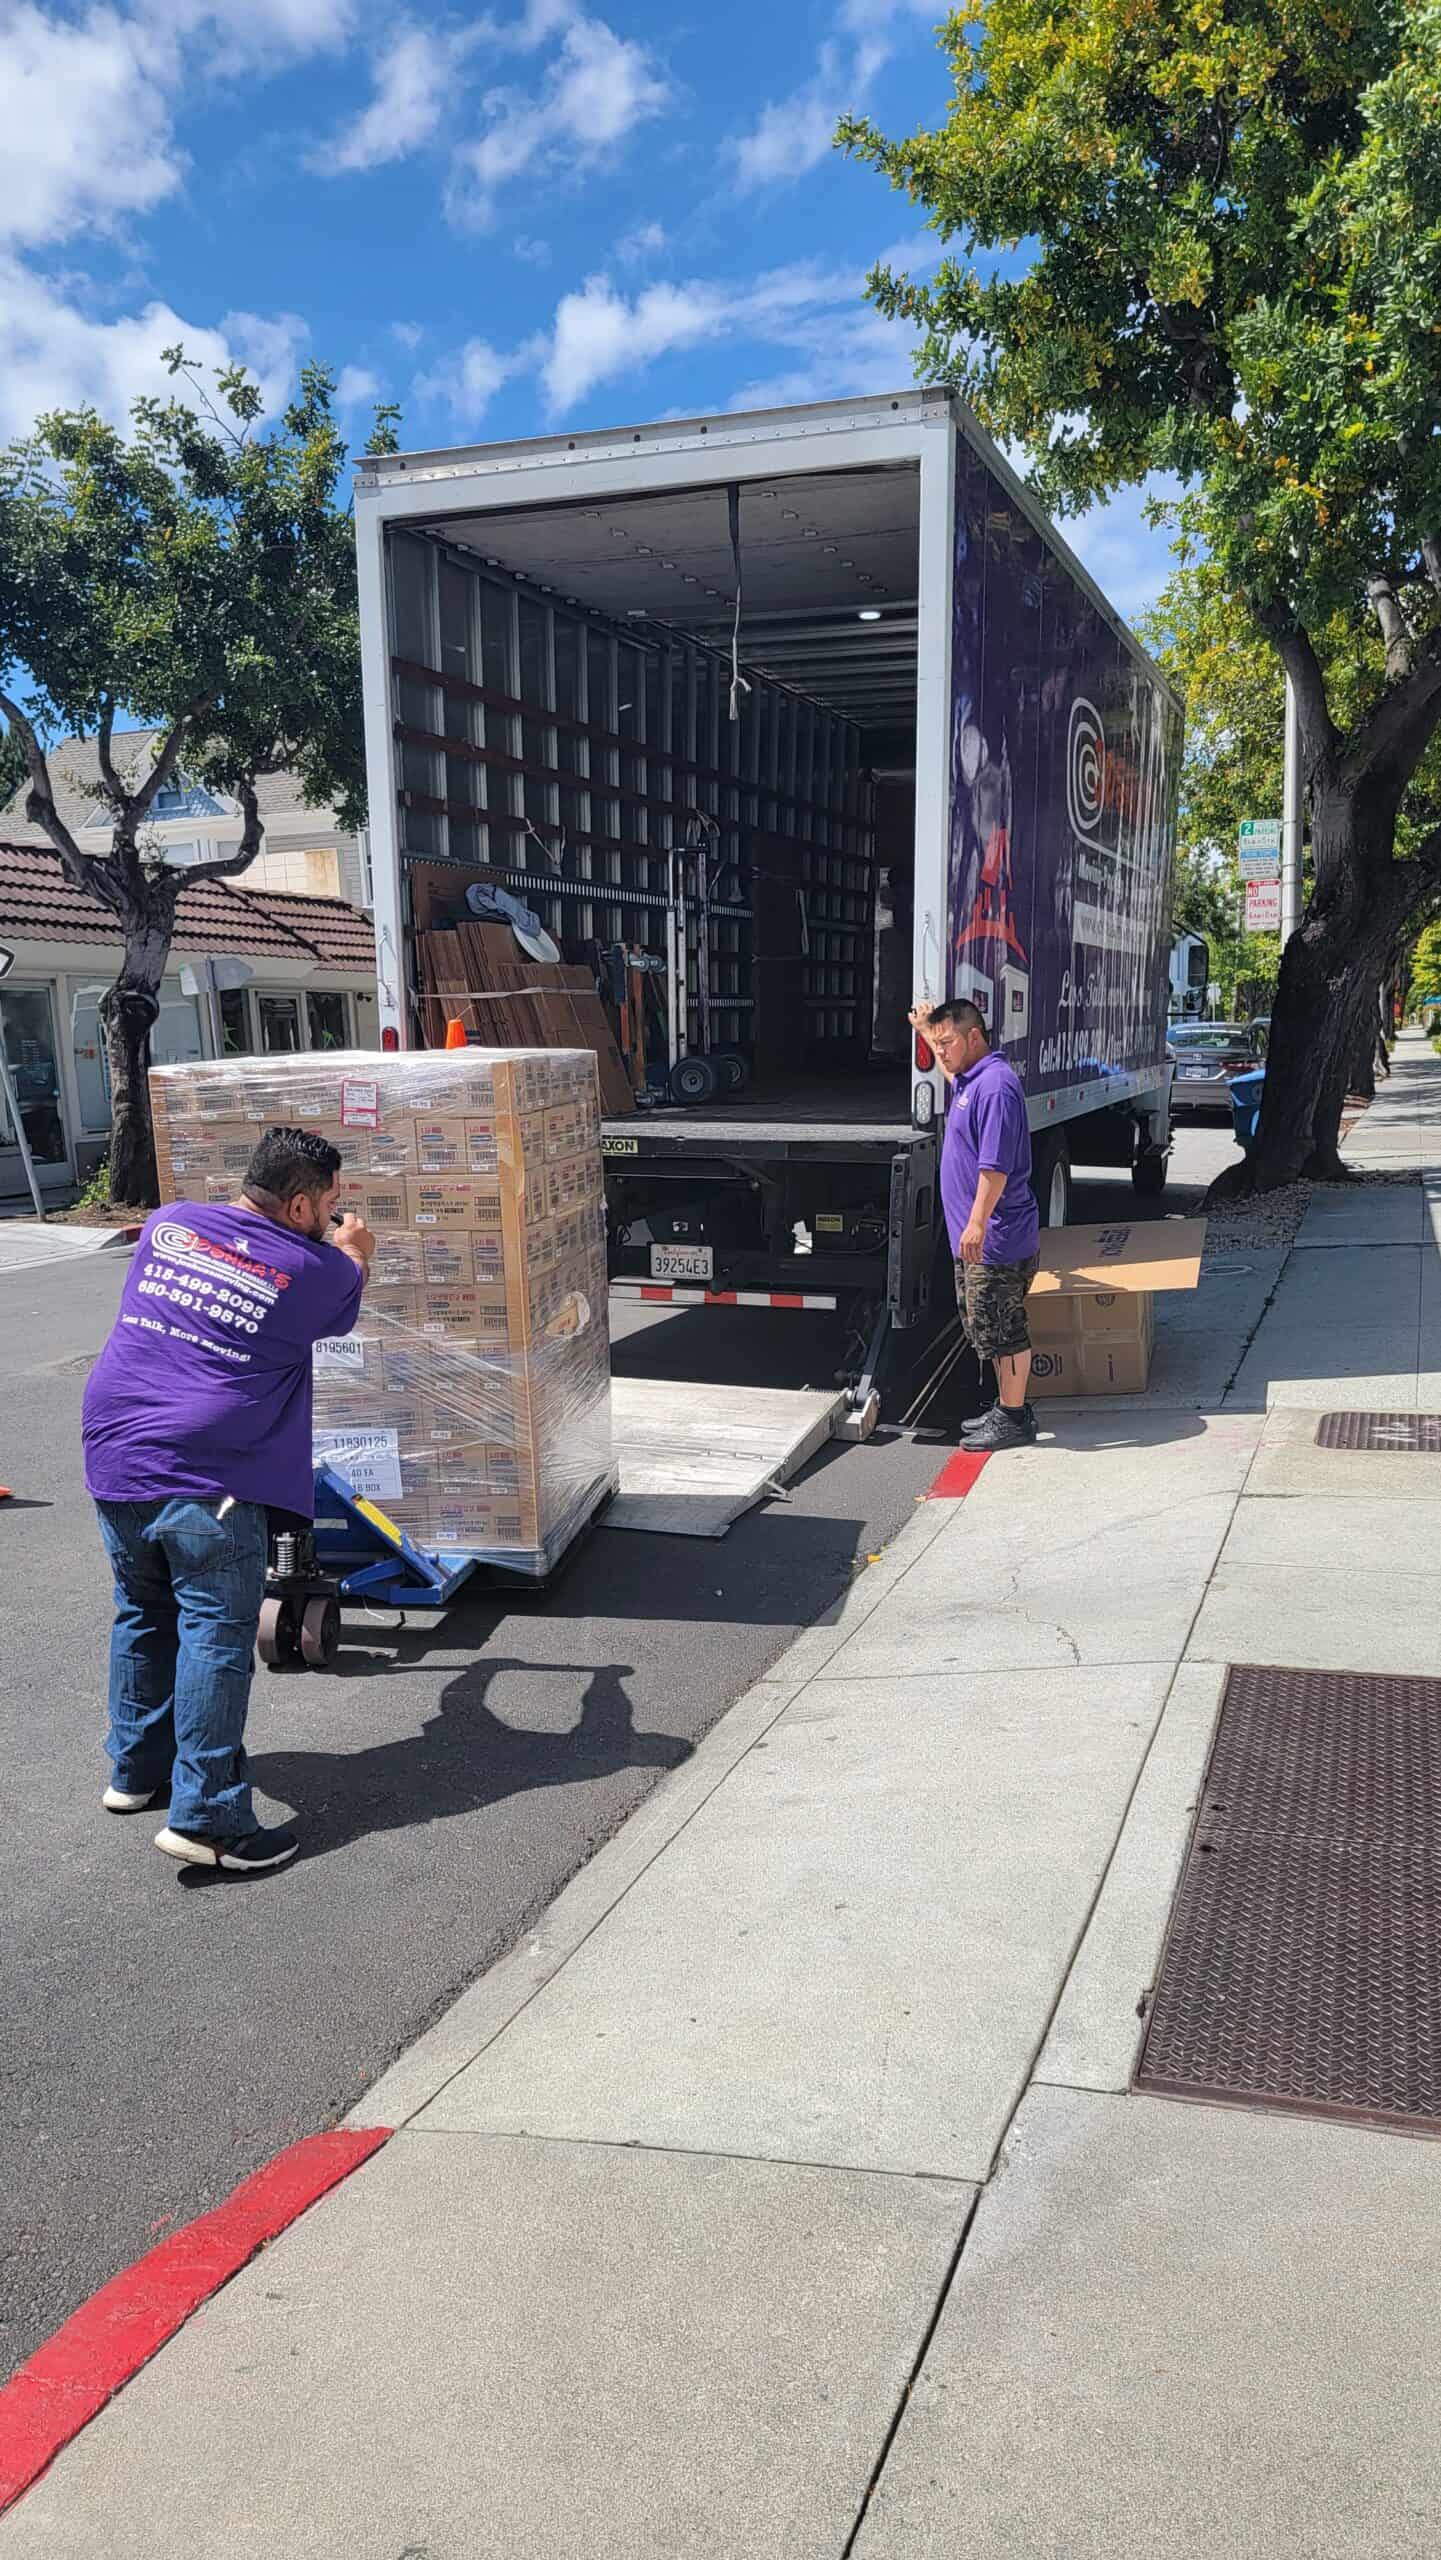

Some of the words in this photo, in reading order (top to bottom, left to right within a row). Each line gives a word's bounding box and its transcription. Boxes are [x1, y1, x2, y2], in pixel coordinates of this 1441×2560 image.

[1244, 823, 1252, 834] 2
[1248, 886, 1257, 897] NO
[600, 1140, 634, 1152] AXON
[655, 1256, 709, 1275] 39254E3
[143, 1263, 268, 1320] 415-499-2093
[137, 1279, 259, 1335] 650-391-9570
[169, 1326, 199, 1344] More
